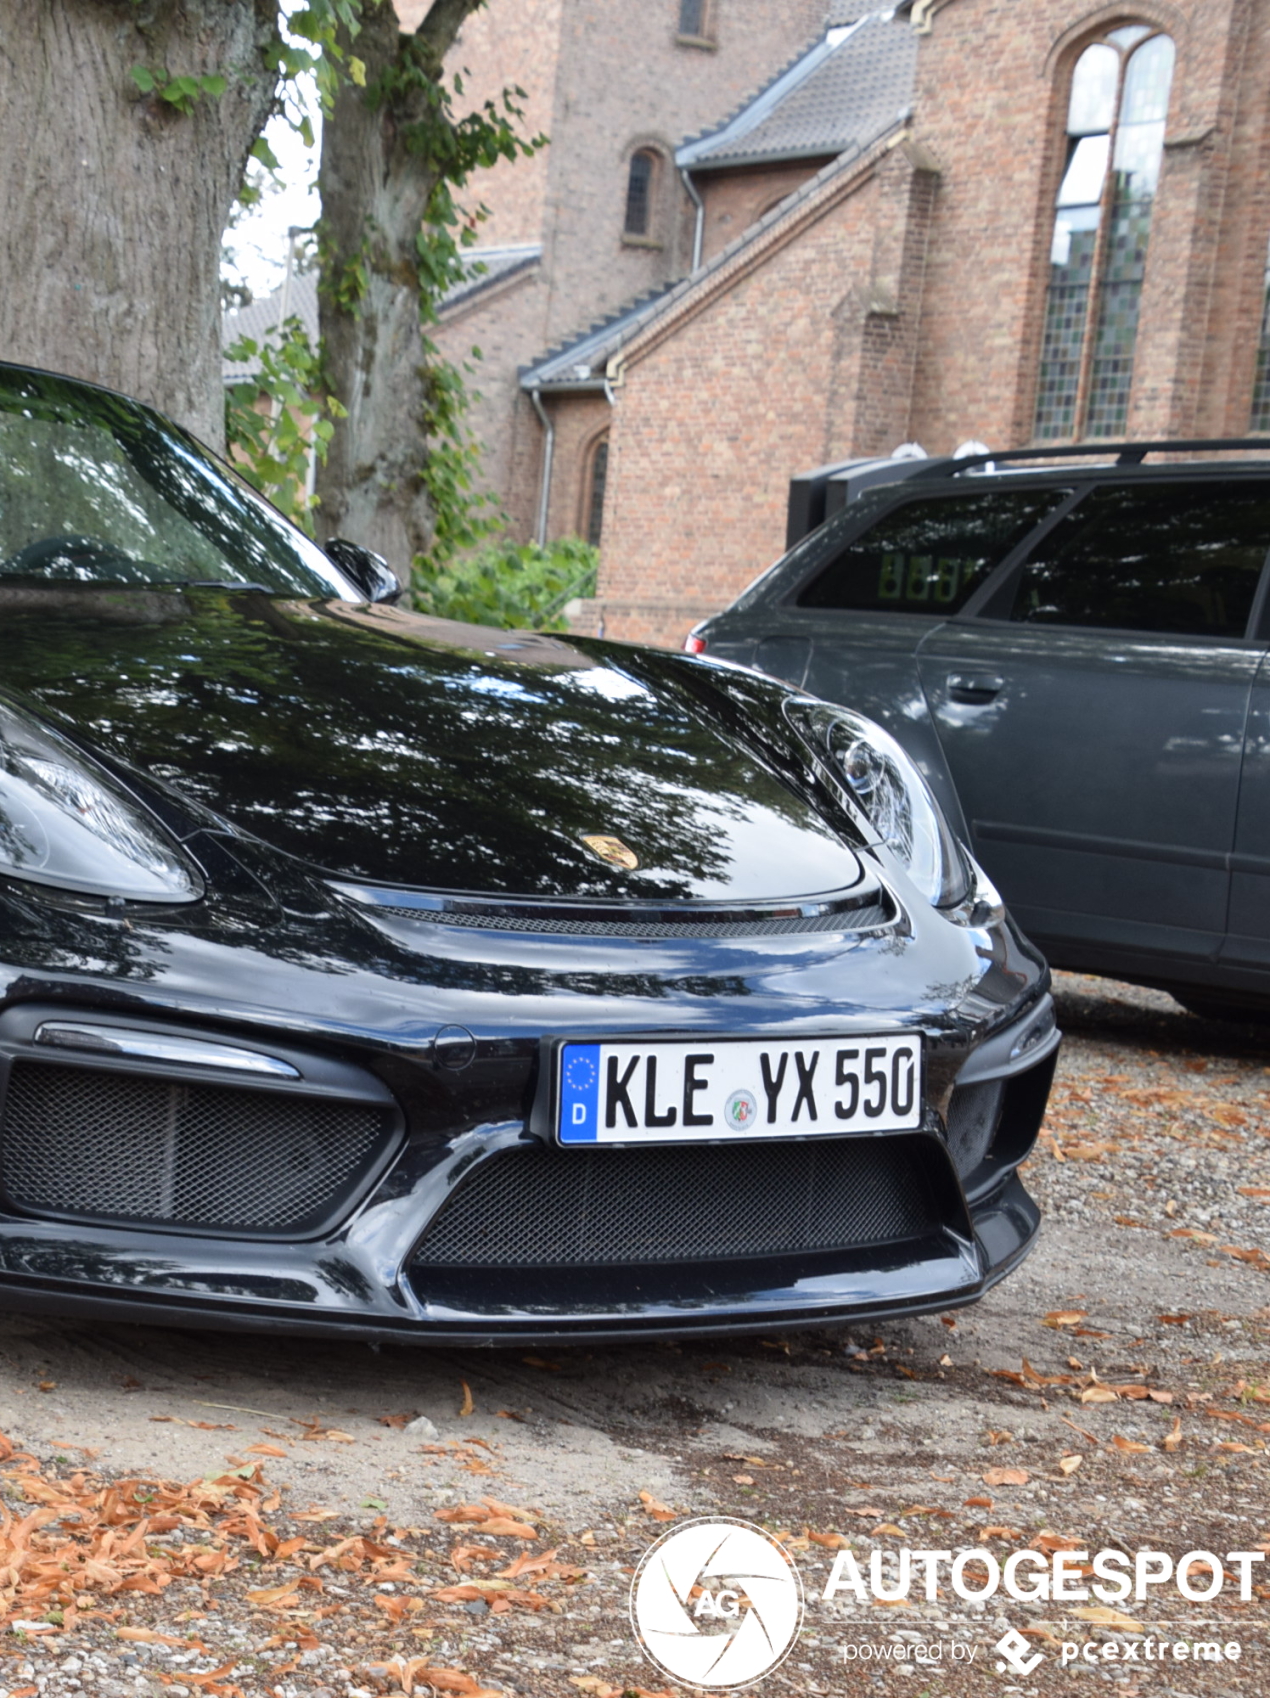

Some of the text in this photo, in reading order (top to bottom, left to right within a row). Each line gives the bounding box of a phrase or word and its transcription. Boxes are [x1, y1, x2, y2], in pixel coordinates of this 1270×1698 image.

[605, 1054, 715, 1128] KLE
[760, 1050, 820, 1123] YX
[835, 1047, 915, 1119] 550
[572, 1103, 586, 1125] D
